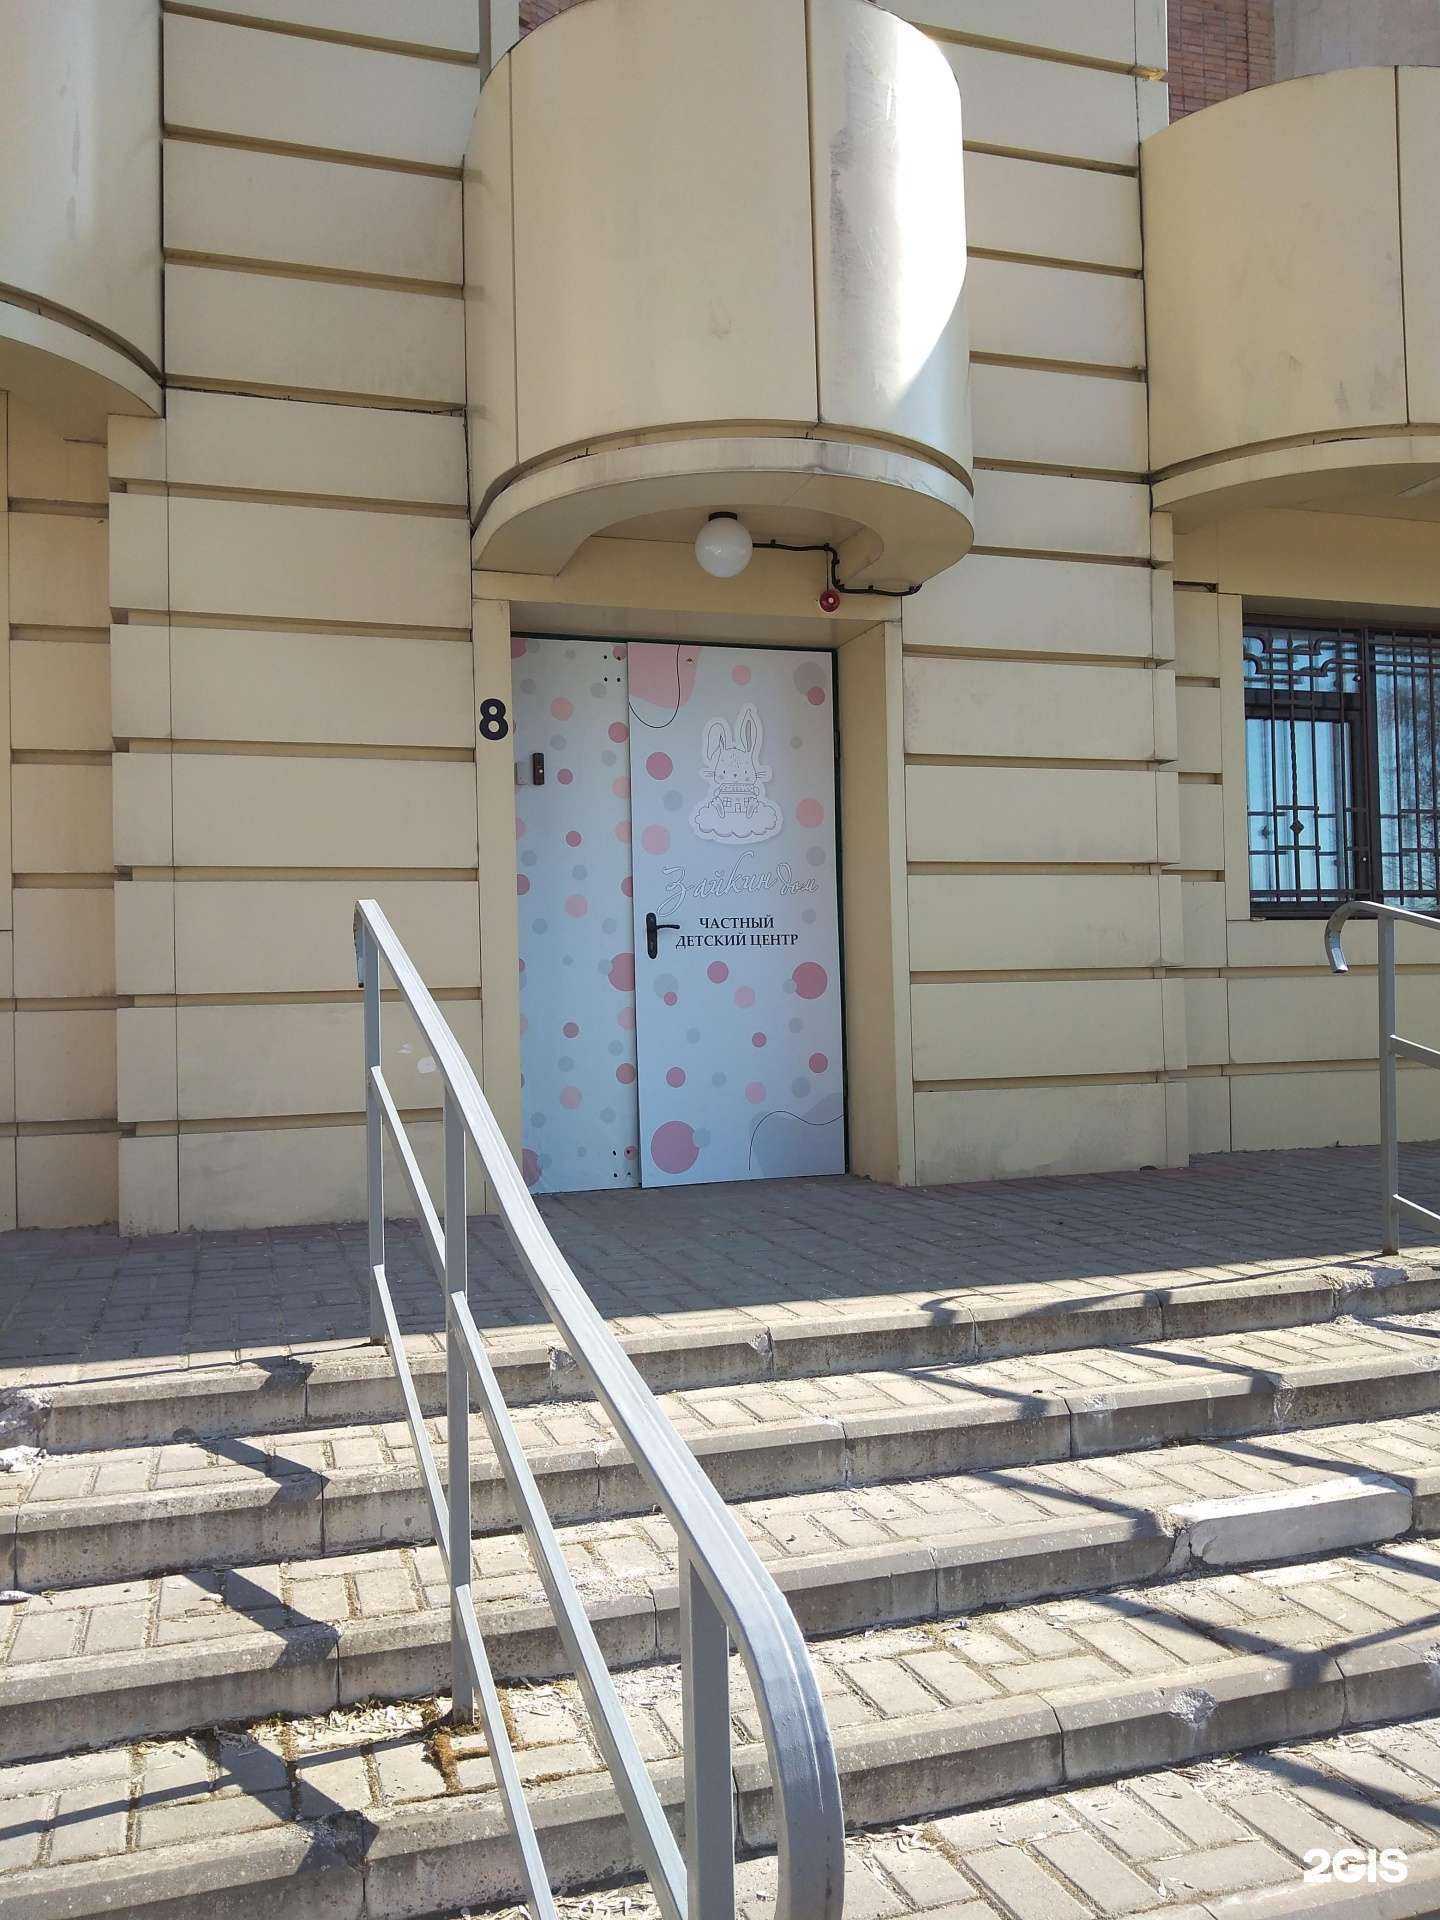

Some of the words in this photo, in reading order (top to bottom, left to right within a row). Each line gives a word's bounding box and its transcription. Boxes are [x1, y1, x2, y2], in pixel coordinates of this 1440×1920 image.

[479, 698, 508, 740] 8
[656, 850, 776, 917] Зайкин
[777, 862, 818, 895] дом
[699, 914, 775, 929] ЧАСТНЫЙ
[675, 931, 746, 949] ДЕТСКИЙ
[750, 934, 799, 948] ЦЕНТР
